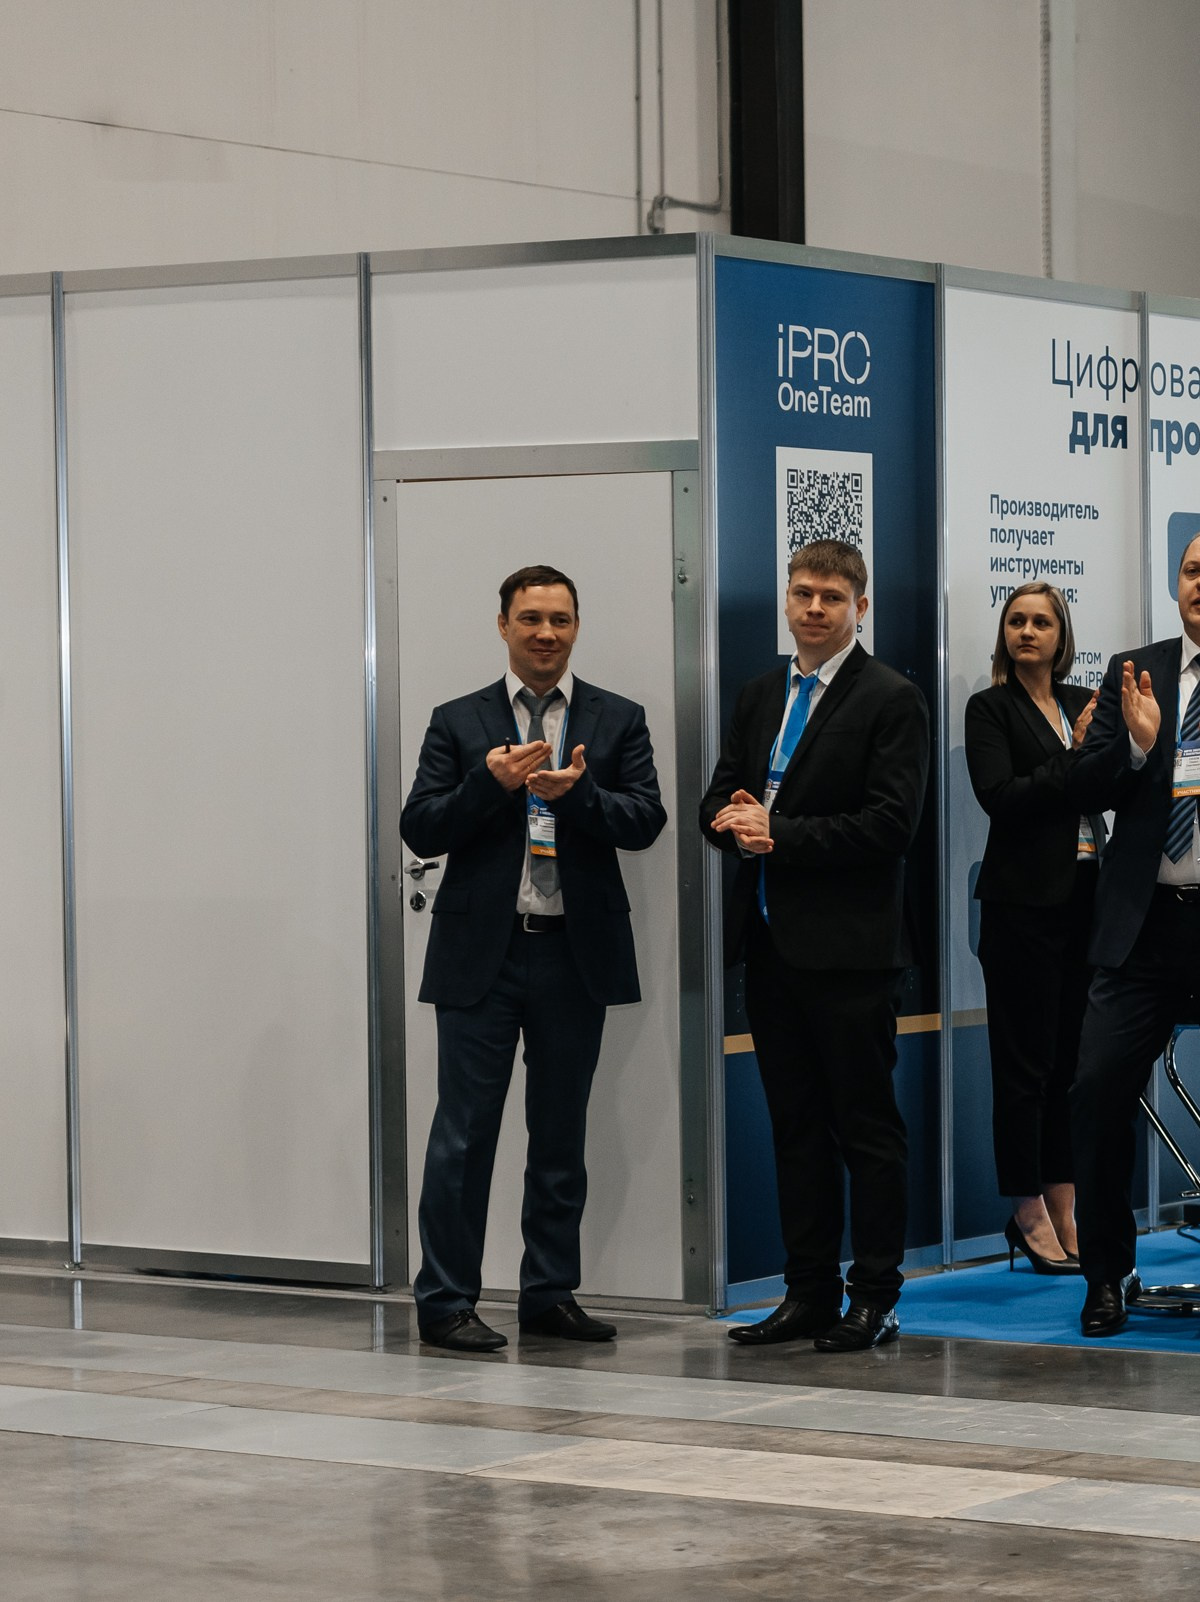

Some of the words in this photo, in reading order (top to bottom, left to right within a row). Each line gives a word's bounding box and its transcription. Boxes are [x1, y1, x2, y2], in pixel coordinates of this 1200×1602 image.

[778, 323, 871, 385] iPRO
[778, 382, 871, 418] OneTeam
[1069, 411, 1128, 455] для
[990, 494, 1099, 522] Производитель
[990, 527, 1055, 551] получает
[990, 556, 1084, 580] инструменты
